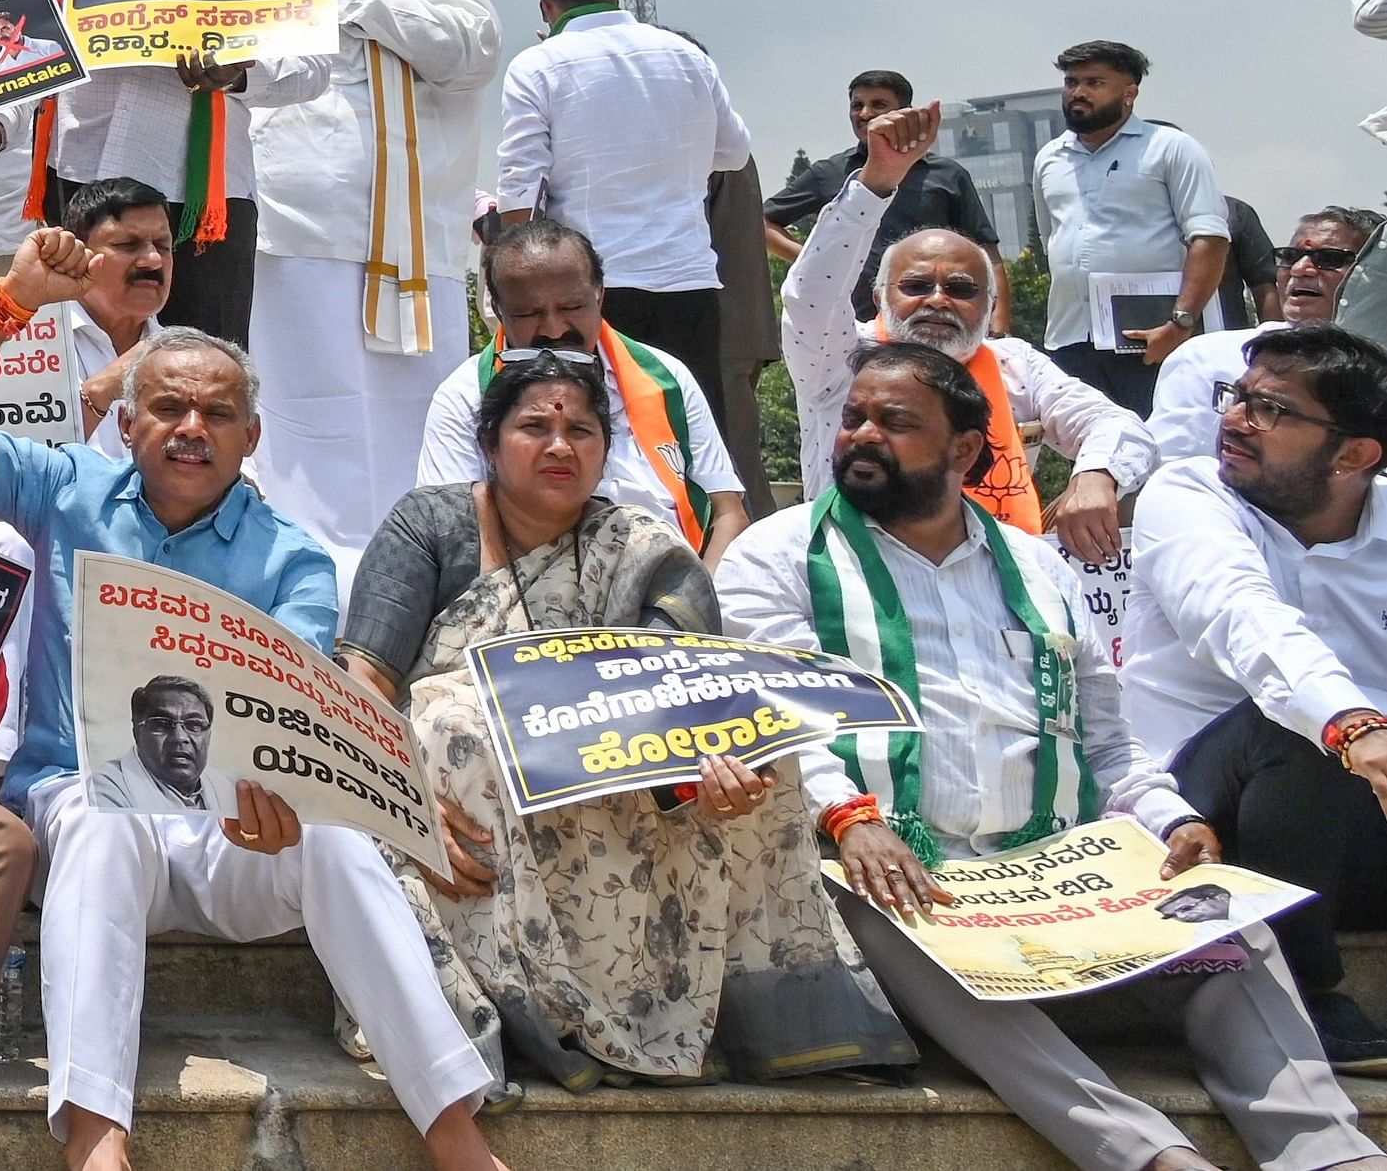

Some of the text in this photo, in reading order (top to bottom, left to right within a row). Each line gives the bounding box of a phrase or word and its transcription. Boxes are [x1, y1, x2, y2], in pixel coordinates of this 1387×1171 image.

[77, 0, 320, 32] ಕಾಂಗ್ರೆಸ್ ಸರ್ಕಾರಕ್ಕೆ
[88, 30, 193, 57] ಧಿಕ್ಕಾರ...
[99, 583, 405, 742] ಬಡವರ ಭೂಮಿ ನುಂಗಿದ
[514, 633, 666, 663] ಎಲ್ಲಿವರೆಗೂ
[594, 648, 746, 681] ಕಾಂಗ್ರೆಸ್
[225, 691, 424, 807] ರಾಜೀನಾಮೆ
[252, 744, 431, 838] ಯಾವಾಗ?
[1053, 872, 1114, 898] ಬಿಡಿ
[932, 903, 1096, 929] ರಾಜೀನಾಮೆ
